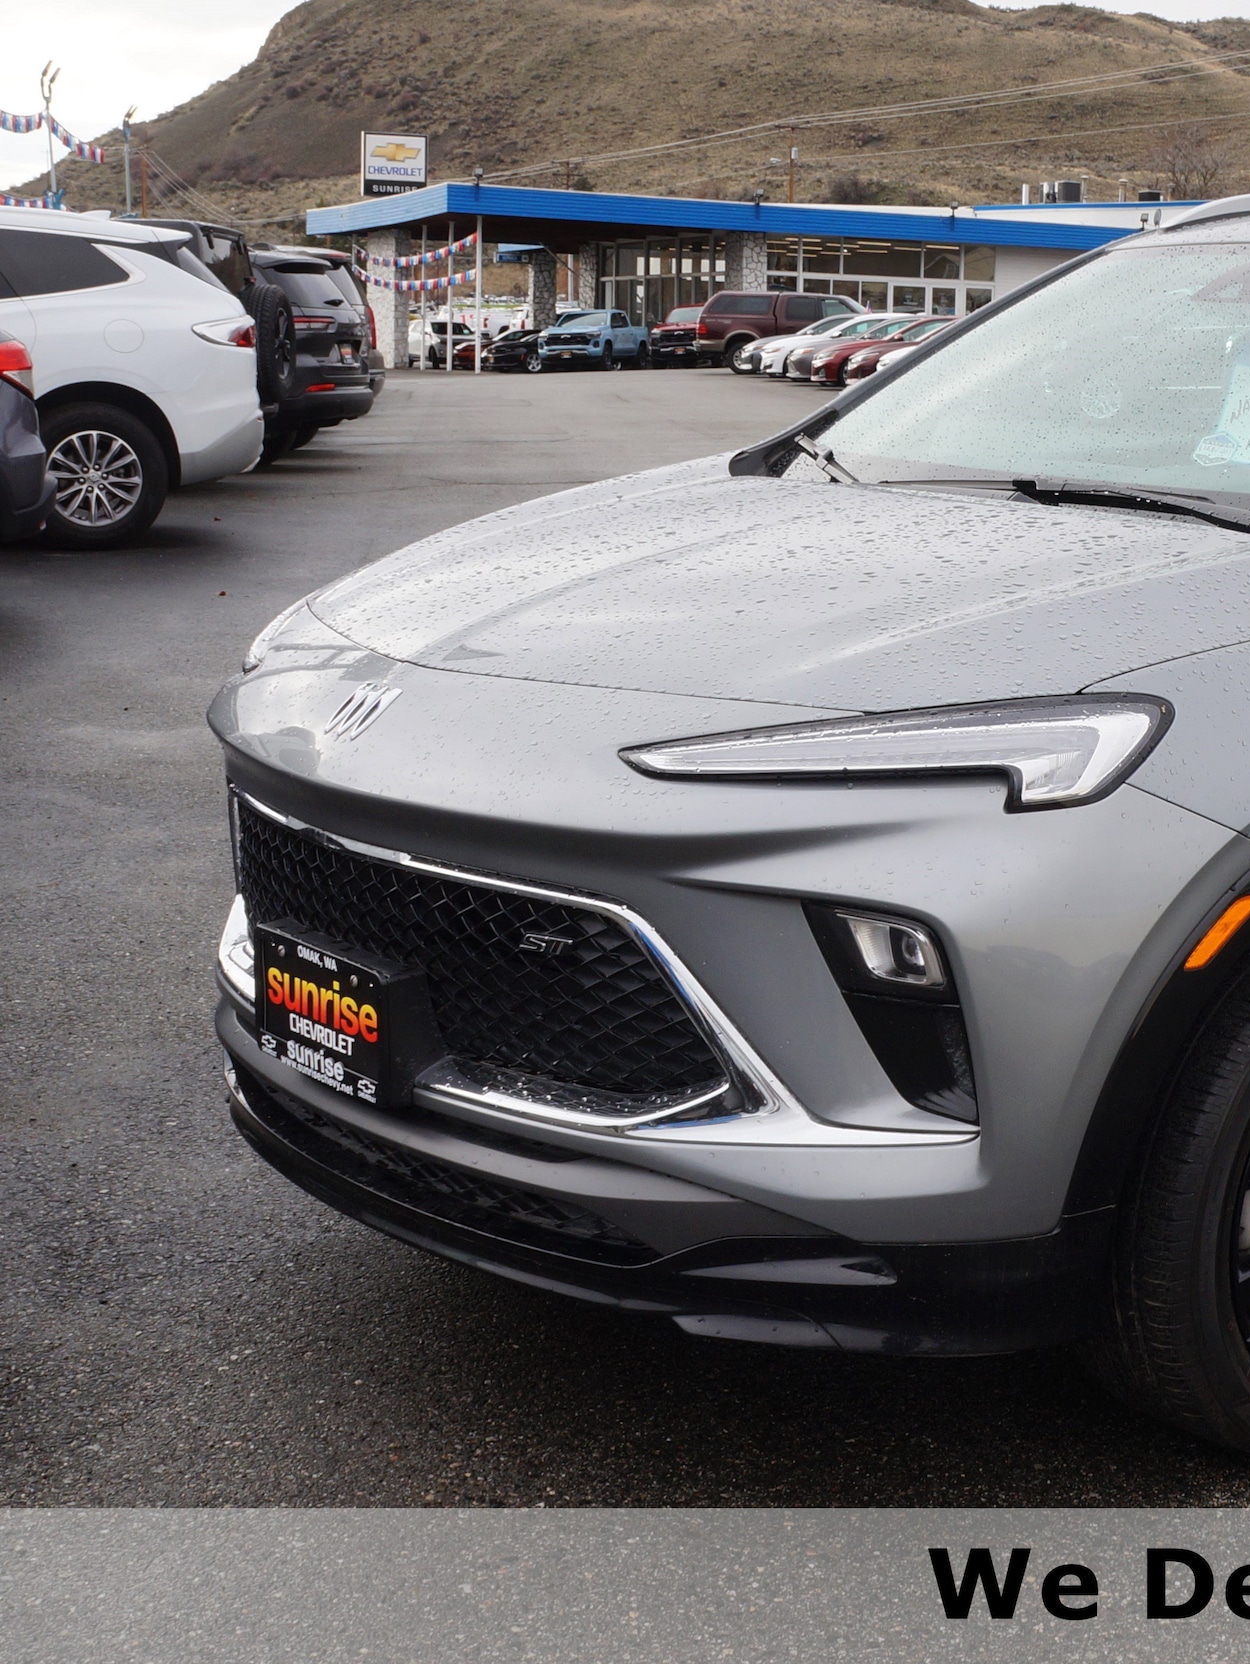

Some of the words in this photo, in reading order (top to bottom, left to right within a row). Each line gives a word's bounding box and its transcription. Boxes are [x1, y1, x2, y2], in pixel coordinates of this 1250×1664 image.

[368, 165, 423, 177] CHEVROLET
[372, 184, 418, 194] SUNRISE
[519, 931, 574, 955] ST
[296, 944, 323, 968] OMAK,
[324, 956, 338, 972] WA
[267, 966, 379, 1043] sunrise
[289, 1012, 355, 1057] CHEVROLET
[286, 1039, 345, 1082] sunrise
